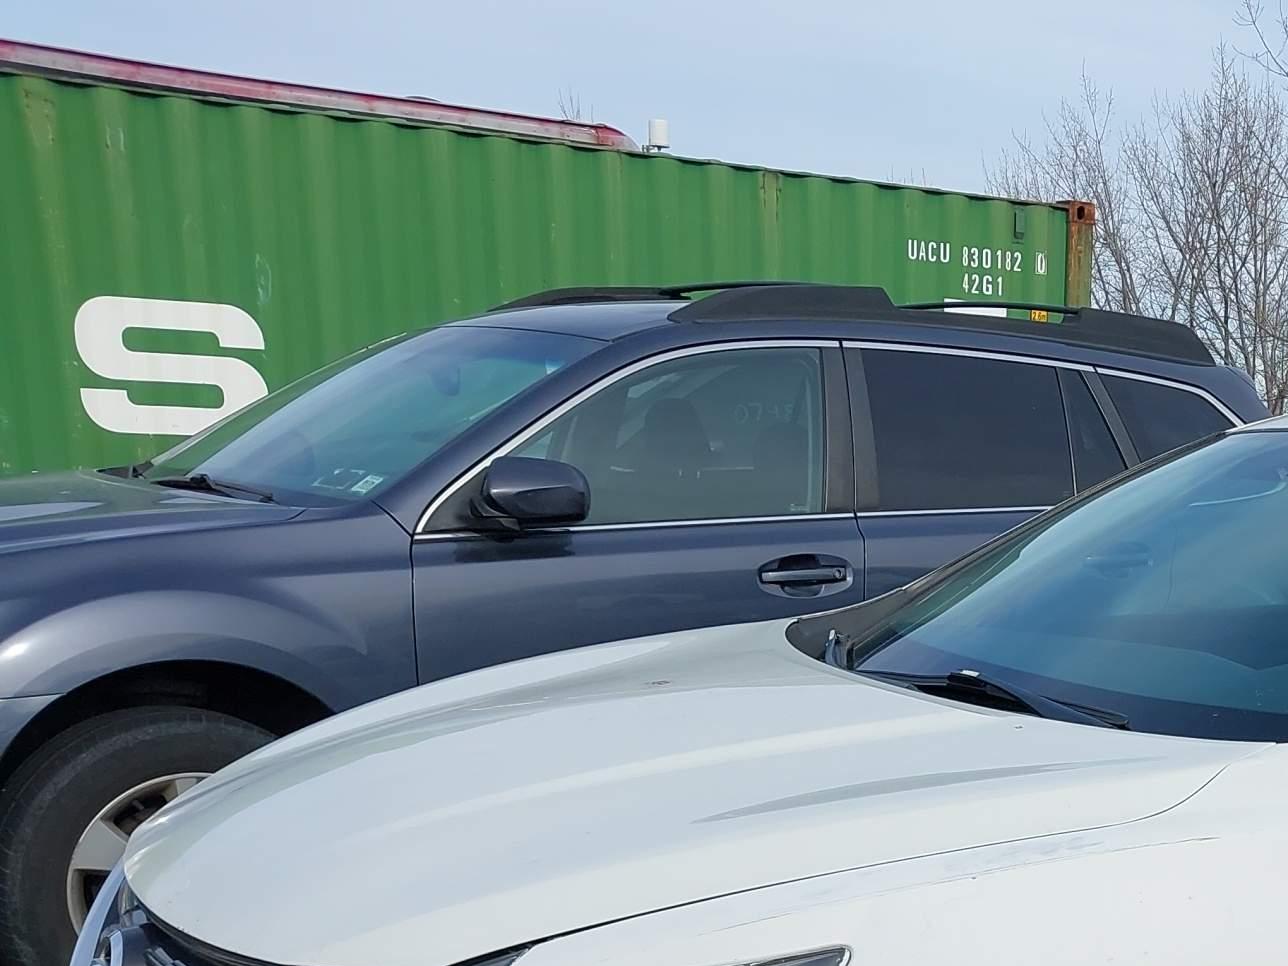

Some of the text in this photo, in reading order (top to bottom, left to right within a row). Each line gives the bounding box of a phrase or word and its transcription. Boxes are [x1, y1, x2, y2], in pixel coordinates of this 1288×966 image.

[908, 239, 950, 263] UACU
[962, 246, 1022, 272] 830182
[962, 273, 1003, 296] 42G1
[74, 296, 269, 435] S
